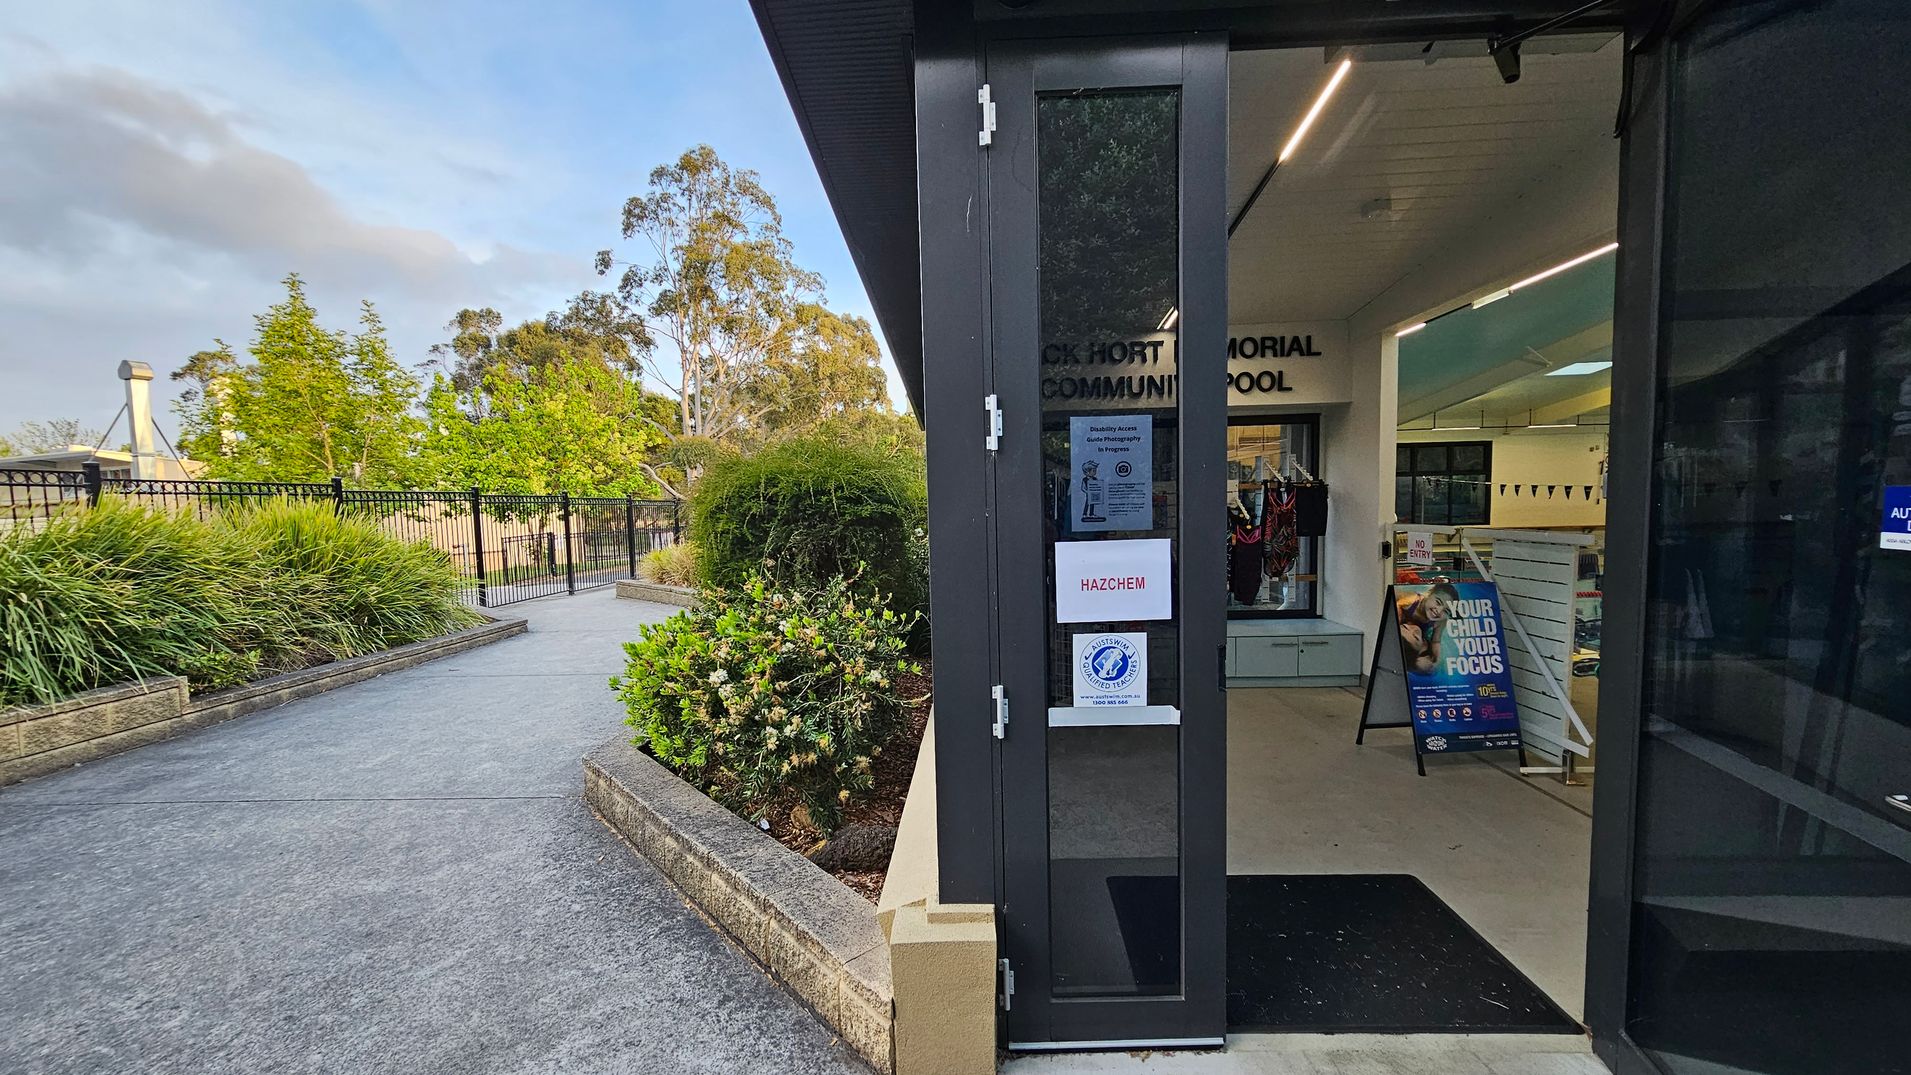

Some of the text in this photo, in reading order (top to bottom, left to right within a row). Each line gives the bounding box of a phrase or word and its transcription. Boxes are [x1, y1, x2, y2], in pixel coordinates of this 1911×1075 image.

[1088, 340, 1165, 365] HORT
[1042, 374, 1177, 400] COMMUNI
[1410, 549, 1430, 559] ENTRY
[1415, 539, 1425, 549] NO
[1081, 576, 1146, 592] HAZCHEM
[1446, 599, 1495, 618] YOUR
[1446, 617, 1497, 637] CHILD
[1091, 638, 1130, 651] AUSTSWIM
[1454, 636, 1500, 656] YOUR
[1082, 659, 1138, 689] QUALIFIED TEACHERS
[1446, 655, 1504, 676] FOCUS
